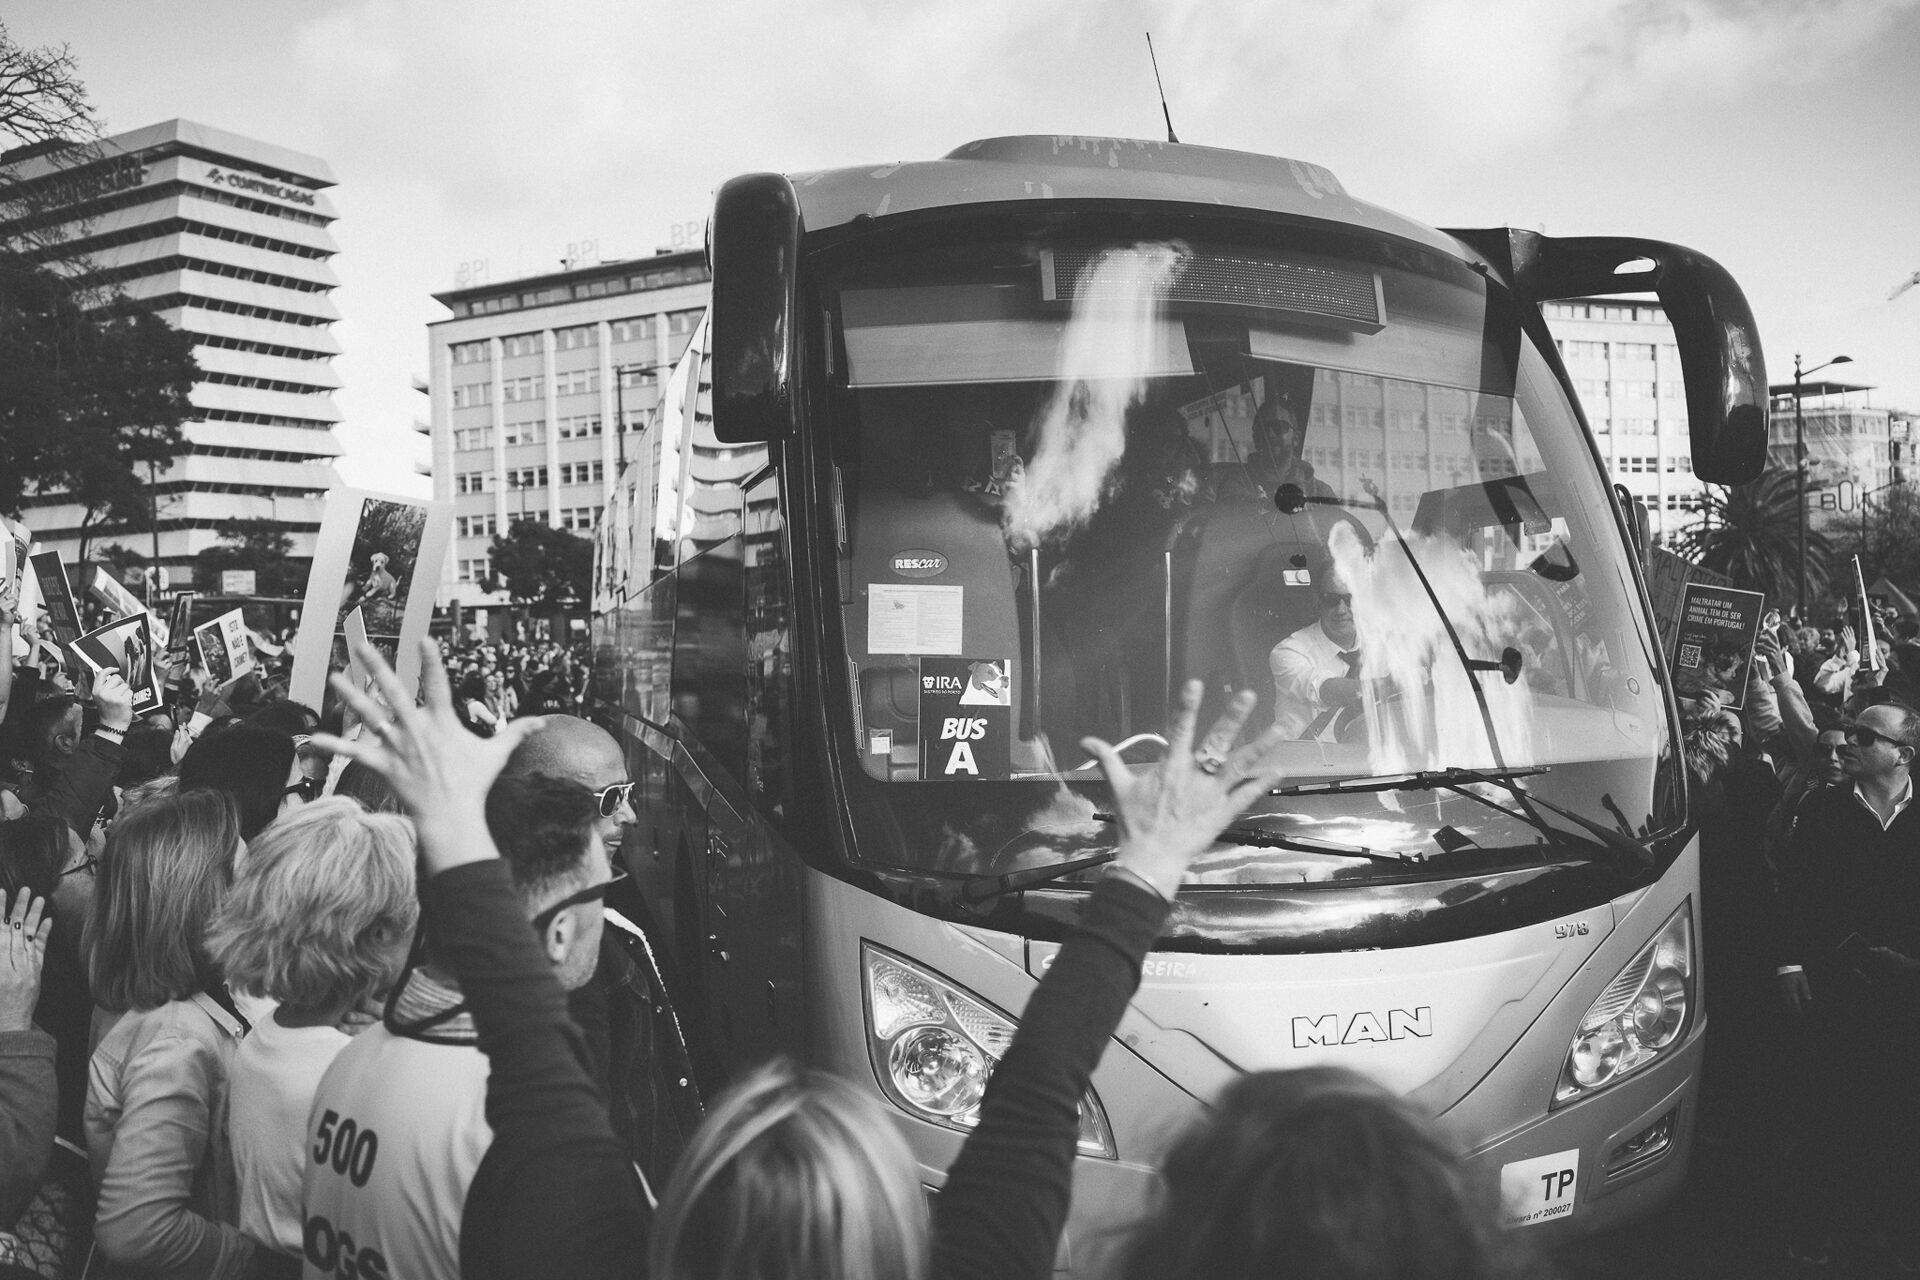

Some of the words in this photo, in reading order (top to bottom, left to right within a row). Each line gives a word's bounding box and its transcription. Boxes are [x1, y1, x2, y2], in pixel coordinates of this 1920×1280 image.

[1690, 596, 1722, 607] MALTRATAR
[1722, 600, 1733, 609] UM
[1687, 614, 1704, 624] CRIME
[1704, 617, 1714, 625] EM
[1714, 618, 1745, 630] PORTUGAL!
[1688, 605, 1709, 616] ANIMAL
[1709, 607, 1721, 618] TEM
[1721, 610, 1730, 619] DE
[1730, 611, 1742, 620] SER
[936, 676, 963, 690] IRA
[940, 717, 988, 740] BUS
[944, 741, 979, 775] A
[1554, 920, 1591, 939] 978
[1142, 960, 1197, 977] REIRA
[1291, 1006, 1433, 1048] MAN
[313, 1108, 378, 1188] 500
[1541, 1169, 1574, 1201] TP
[1543, 1202, 1572, 1217] 200027
[302, 1203, 388, 1280] OGS
